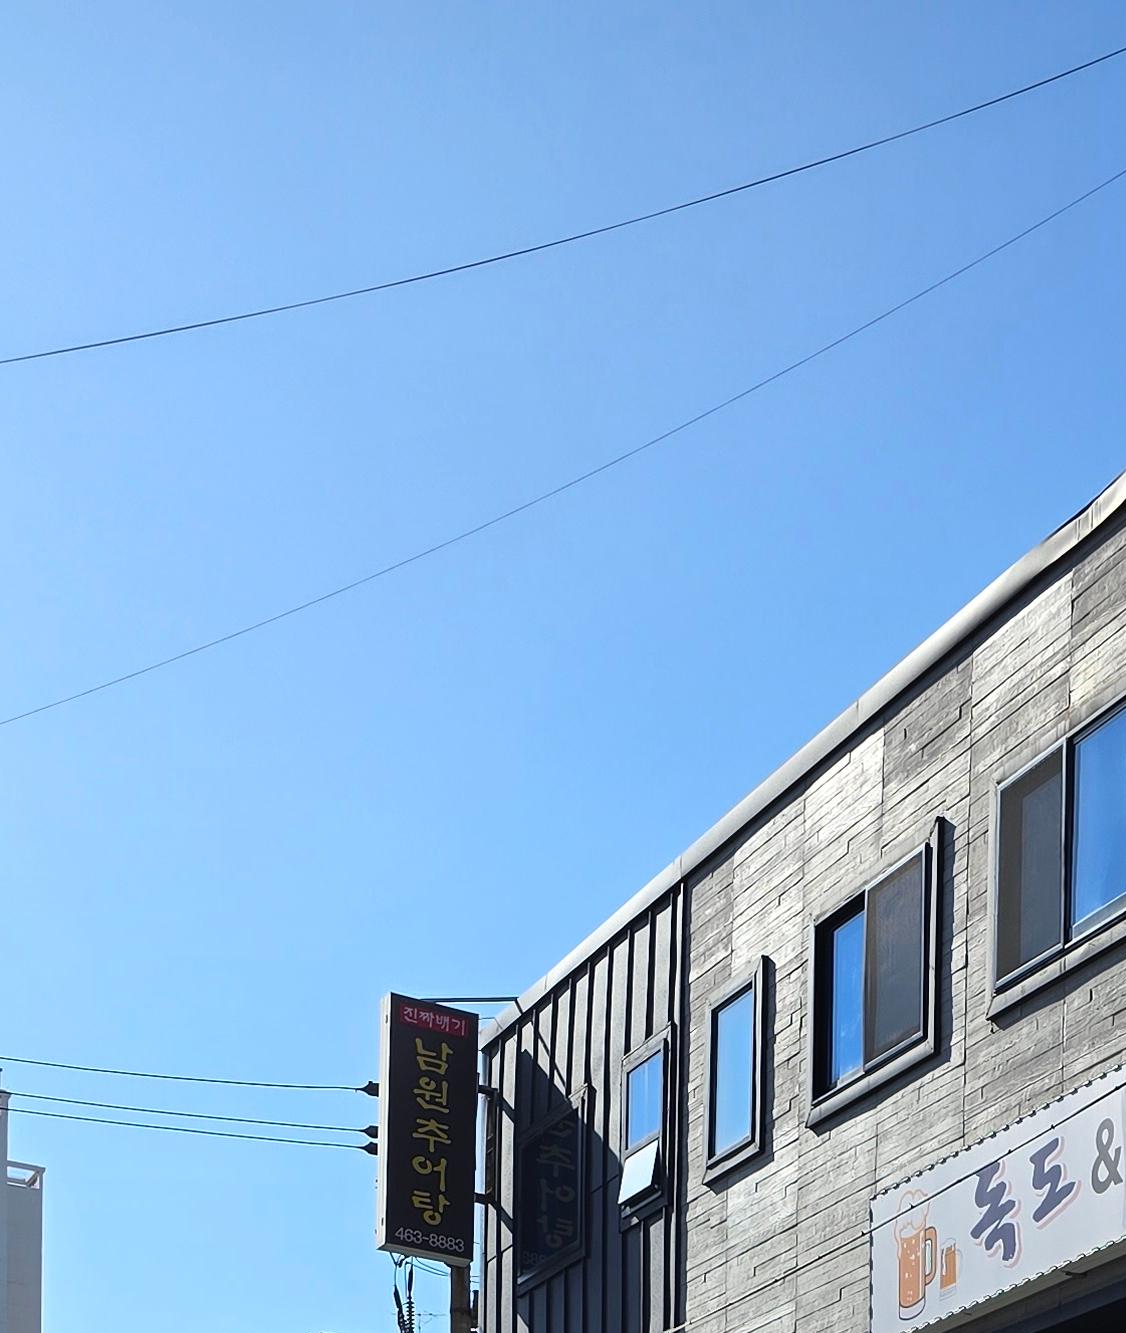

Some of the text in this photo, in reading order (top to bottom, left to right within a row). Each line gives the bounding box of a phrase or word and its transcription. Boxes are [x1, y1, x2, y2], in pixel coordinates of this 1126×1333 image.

[403, 1006, 466, 1036] 진짜배기
[411, 1037, 454, 1226] 남원추어탕
[394, 1226, 465, 1252] 463-8883
